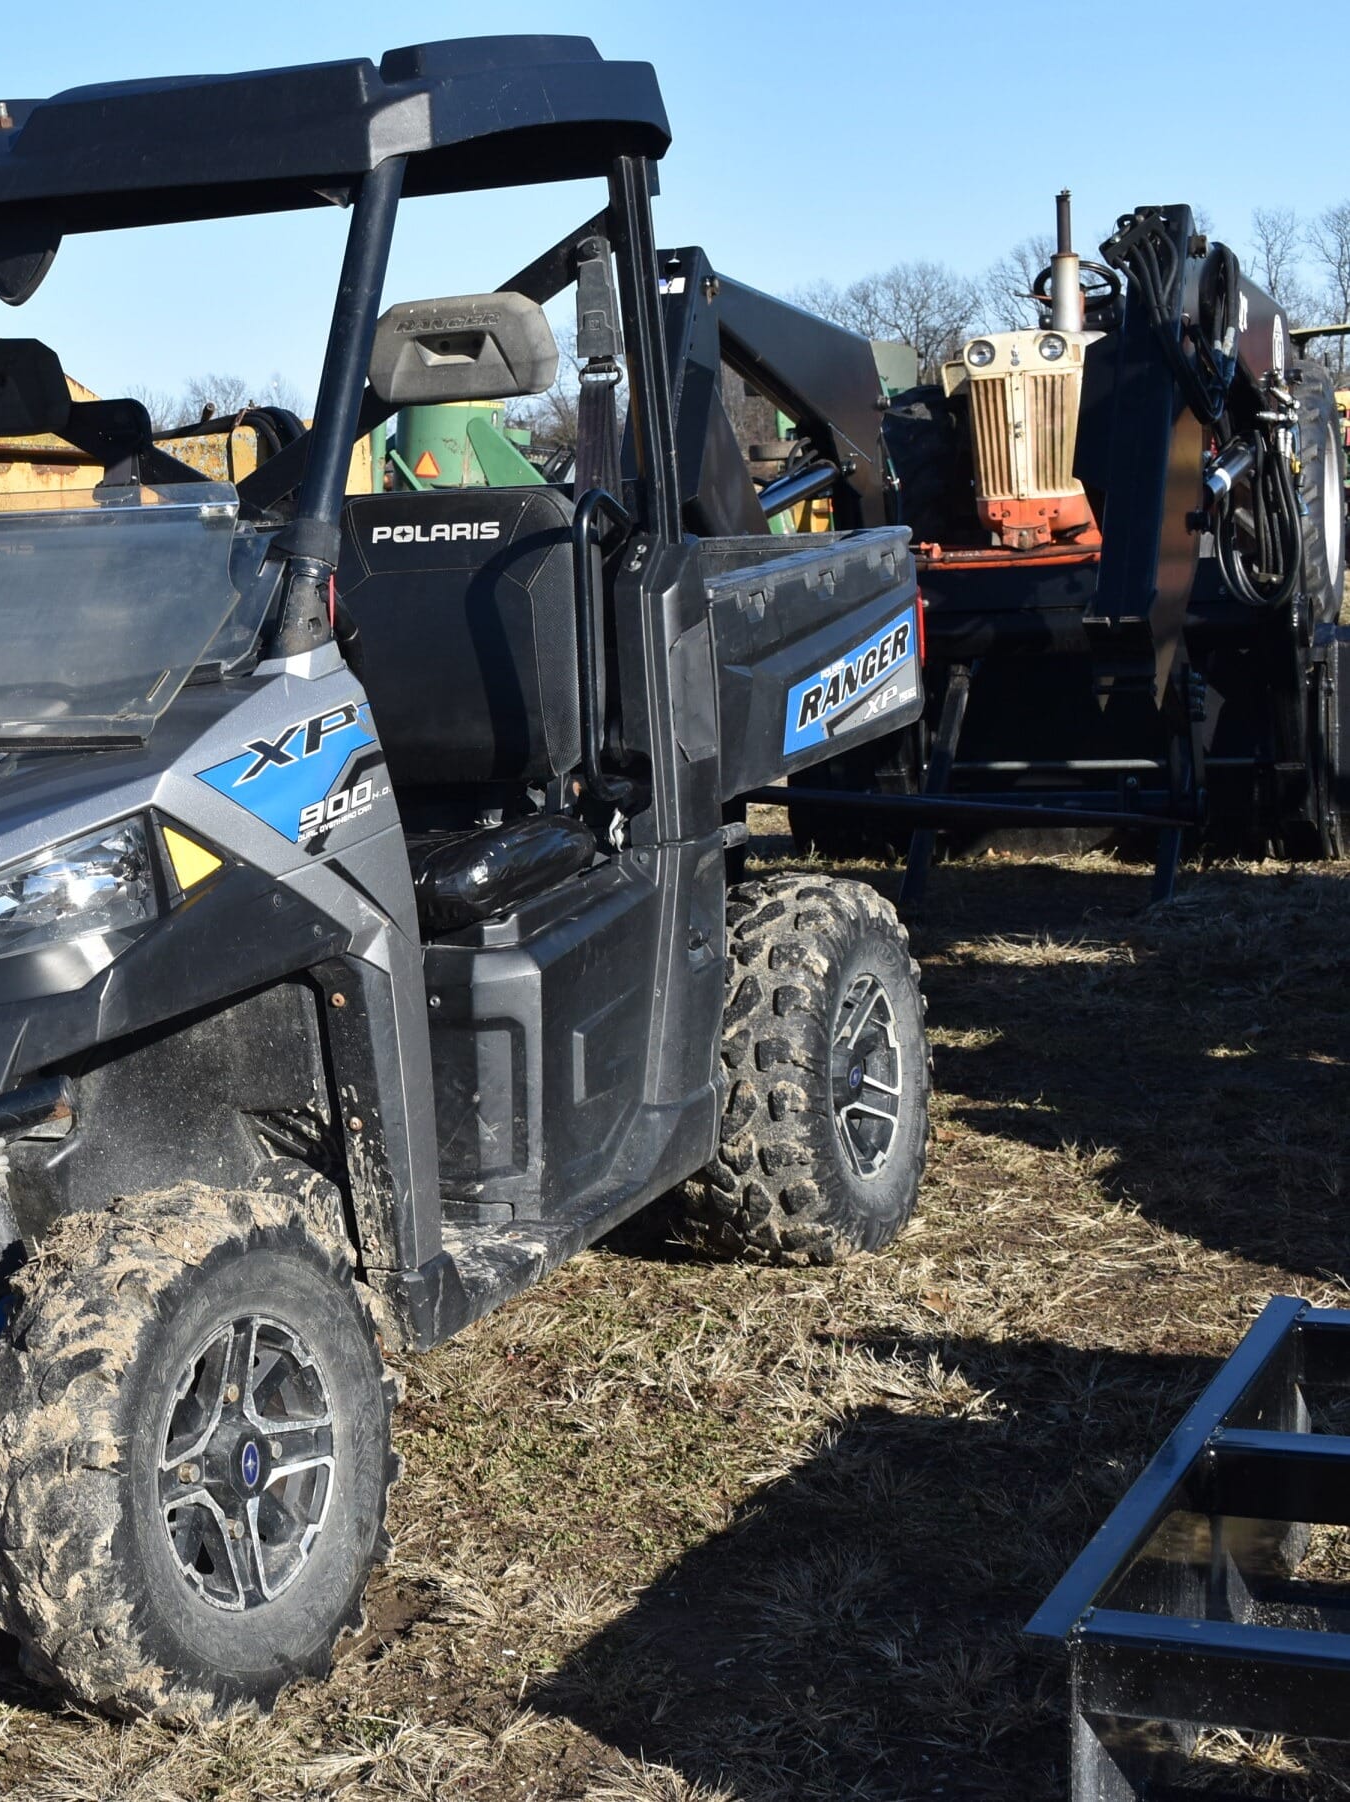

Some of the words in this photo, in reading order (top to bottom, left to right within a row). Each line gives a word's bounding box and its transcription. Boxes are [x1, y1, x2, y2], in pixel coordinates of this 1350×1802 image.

[394, 312, 500, 333] RANGER
[372, 521, 500, 544] POLARIS
[796, 621, 911, 732] RANGER
[863, 685, 898, 720] XP
[232, 700, 359, 788] XP
[298, 778, 373, 832] 900
